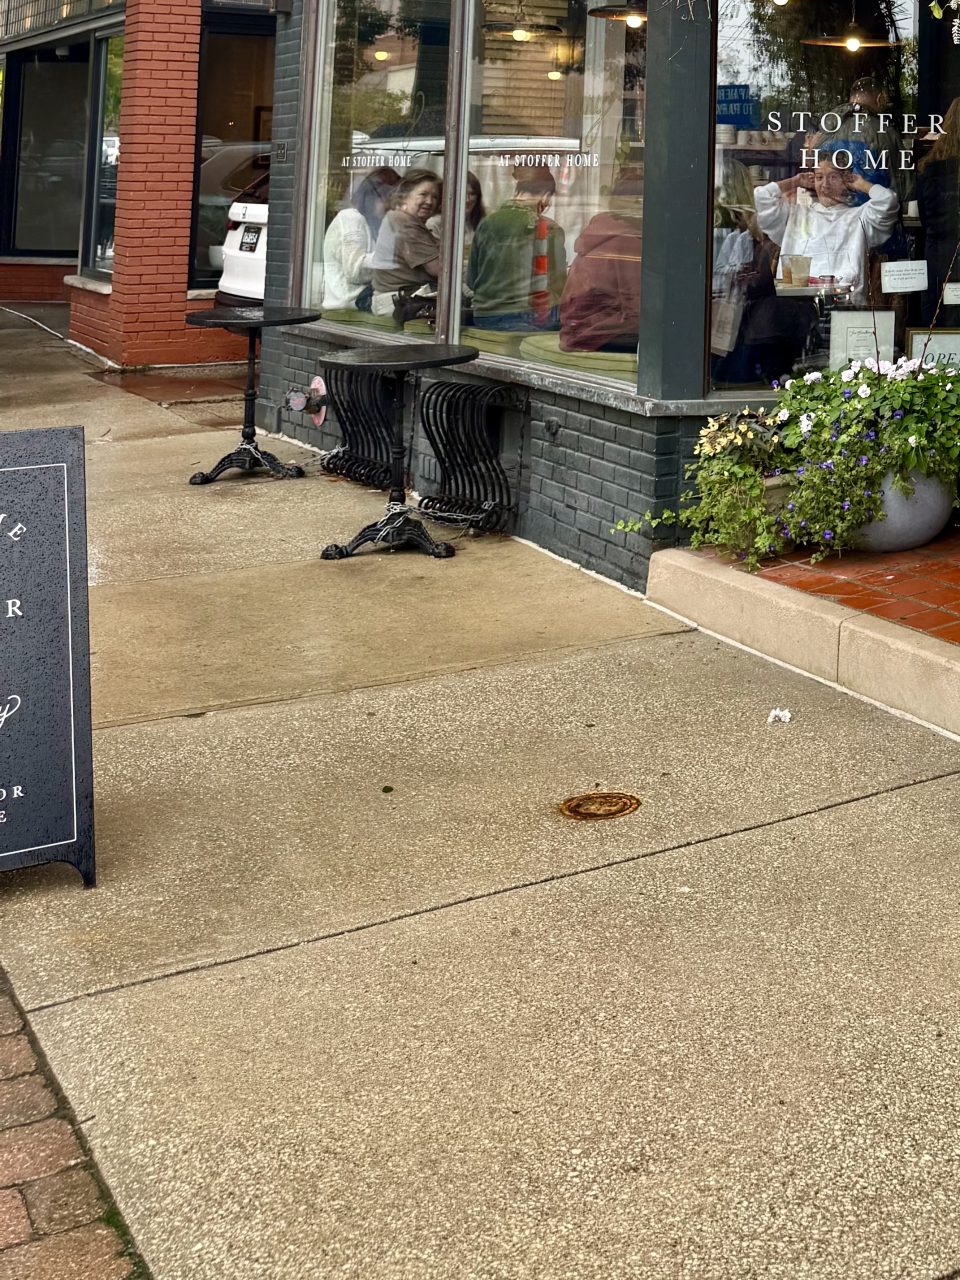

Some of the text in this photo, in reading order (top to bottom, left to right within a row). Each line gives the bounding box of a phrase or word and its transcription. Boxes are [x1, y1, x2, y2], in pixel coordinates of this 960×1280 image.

[767, 111, 948, 135] STOFFER
[341, 155, 412, 167] AT STOFFER HOME
[498, 153, 599, 167] AT STOFFER HOME
[799, 148, 916, 170] HOME
